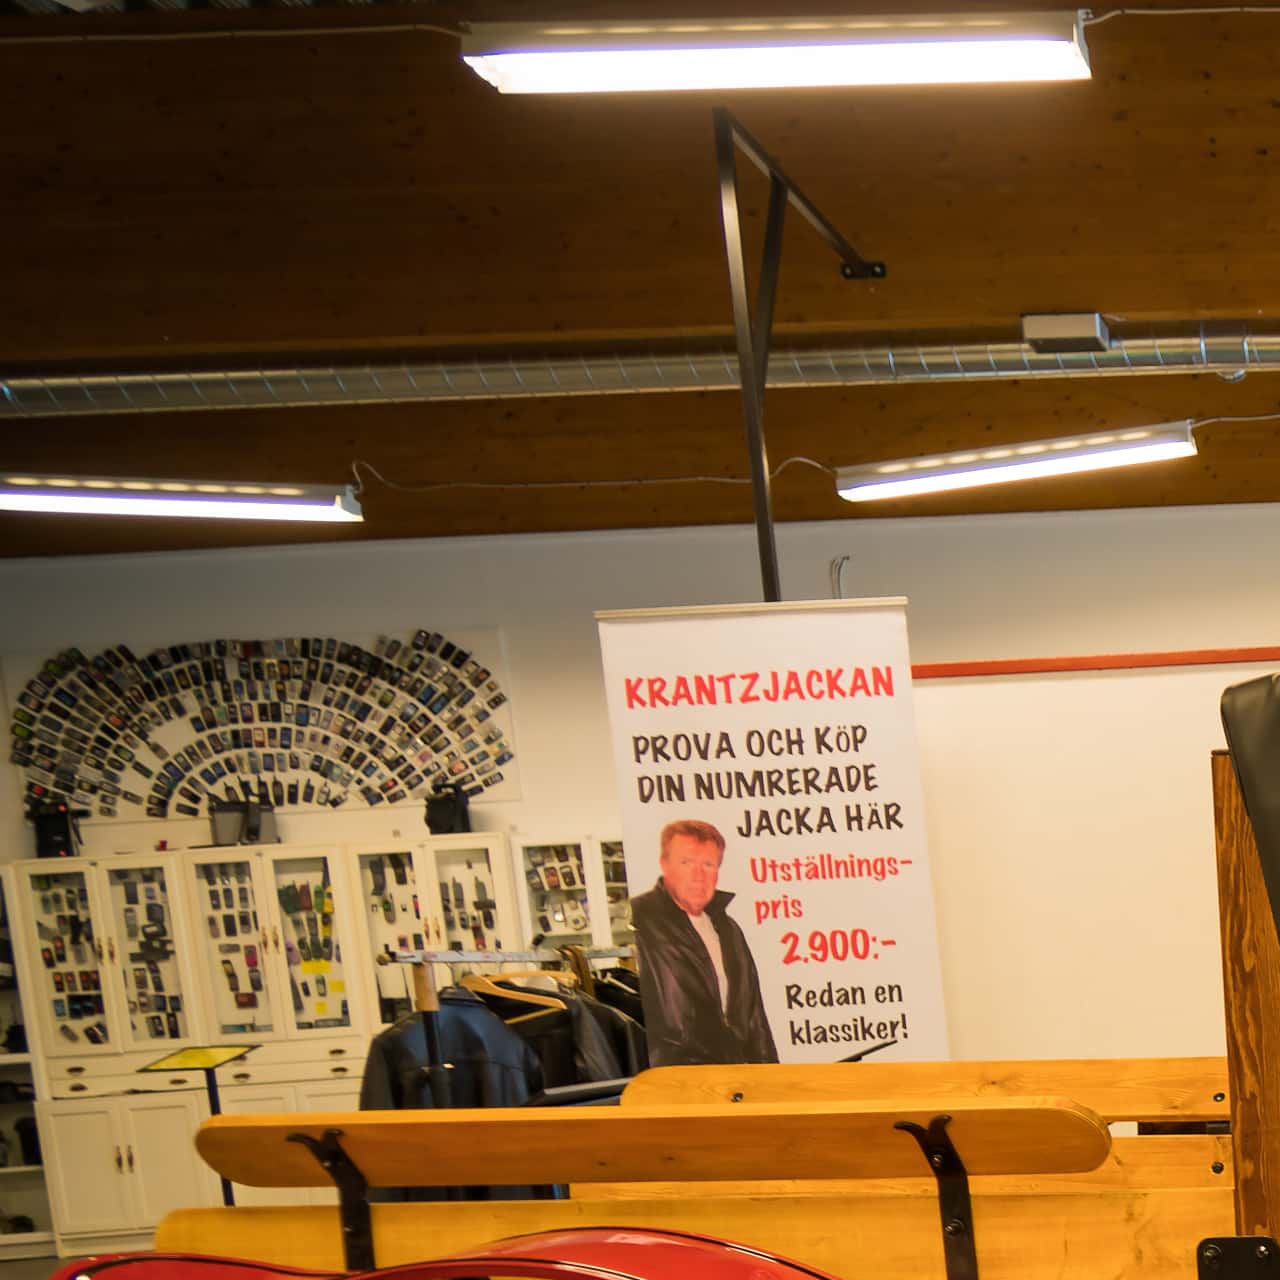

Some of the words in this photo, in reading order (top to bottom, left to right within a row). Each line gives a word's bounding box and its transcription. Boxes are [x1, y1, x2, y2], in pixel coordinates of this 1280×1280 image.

[624, 666, 894, 710] KRANTZJACKAN
[633, 732, 736, 763] PROVA
[747, 728, 804, 757] OCH
[815, 725, 867, 754] KÖP
[638, 774, 685, 803] DIN
[694, 764, 878, 800] NUMRERADE
[737, 807, 836, 837] JACKA
[845, 803, 903, 831] HÄR
[750, 853, 912, 884] Utställnings-
[755, 896, 803, 924] pris
[781, 928, 896, 965] 2.900:-
[786, 982, 865, 1009] Redan
[875, 985, 902, 1003] en
[790, 1014, 908, 1045] klassiker!
